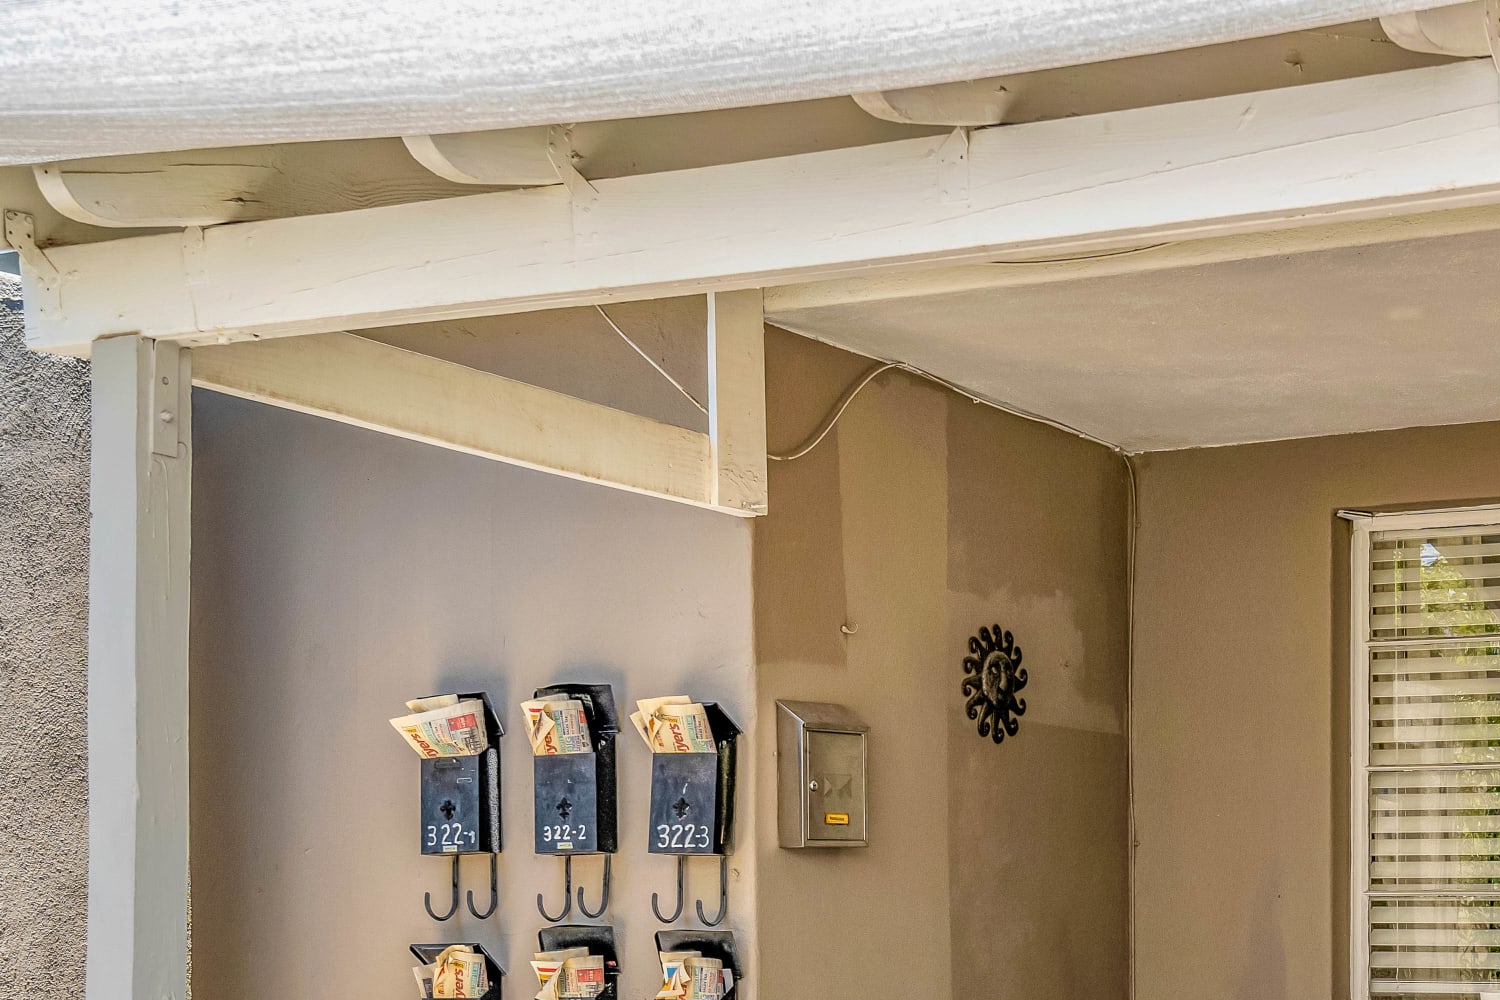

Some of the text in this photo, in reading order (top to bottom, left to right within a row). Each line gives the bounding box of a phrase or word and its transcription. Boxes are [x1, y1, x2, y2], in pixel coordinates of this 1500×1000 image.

[427, 823, 476, 846] 322-1
[543, 824, 587, 841] 322-2
[657, 824, 709, 848] 322-3
